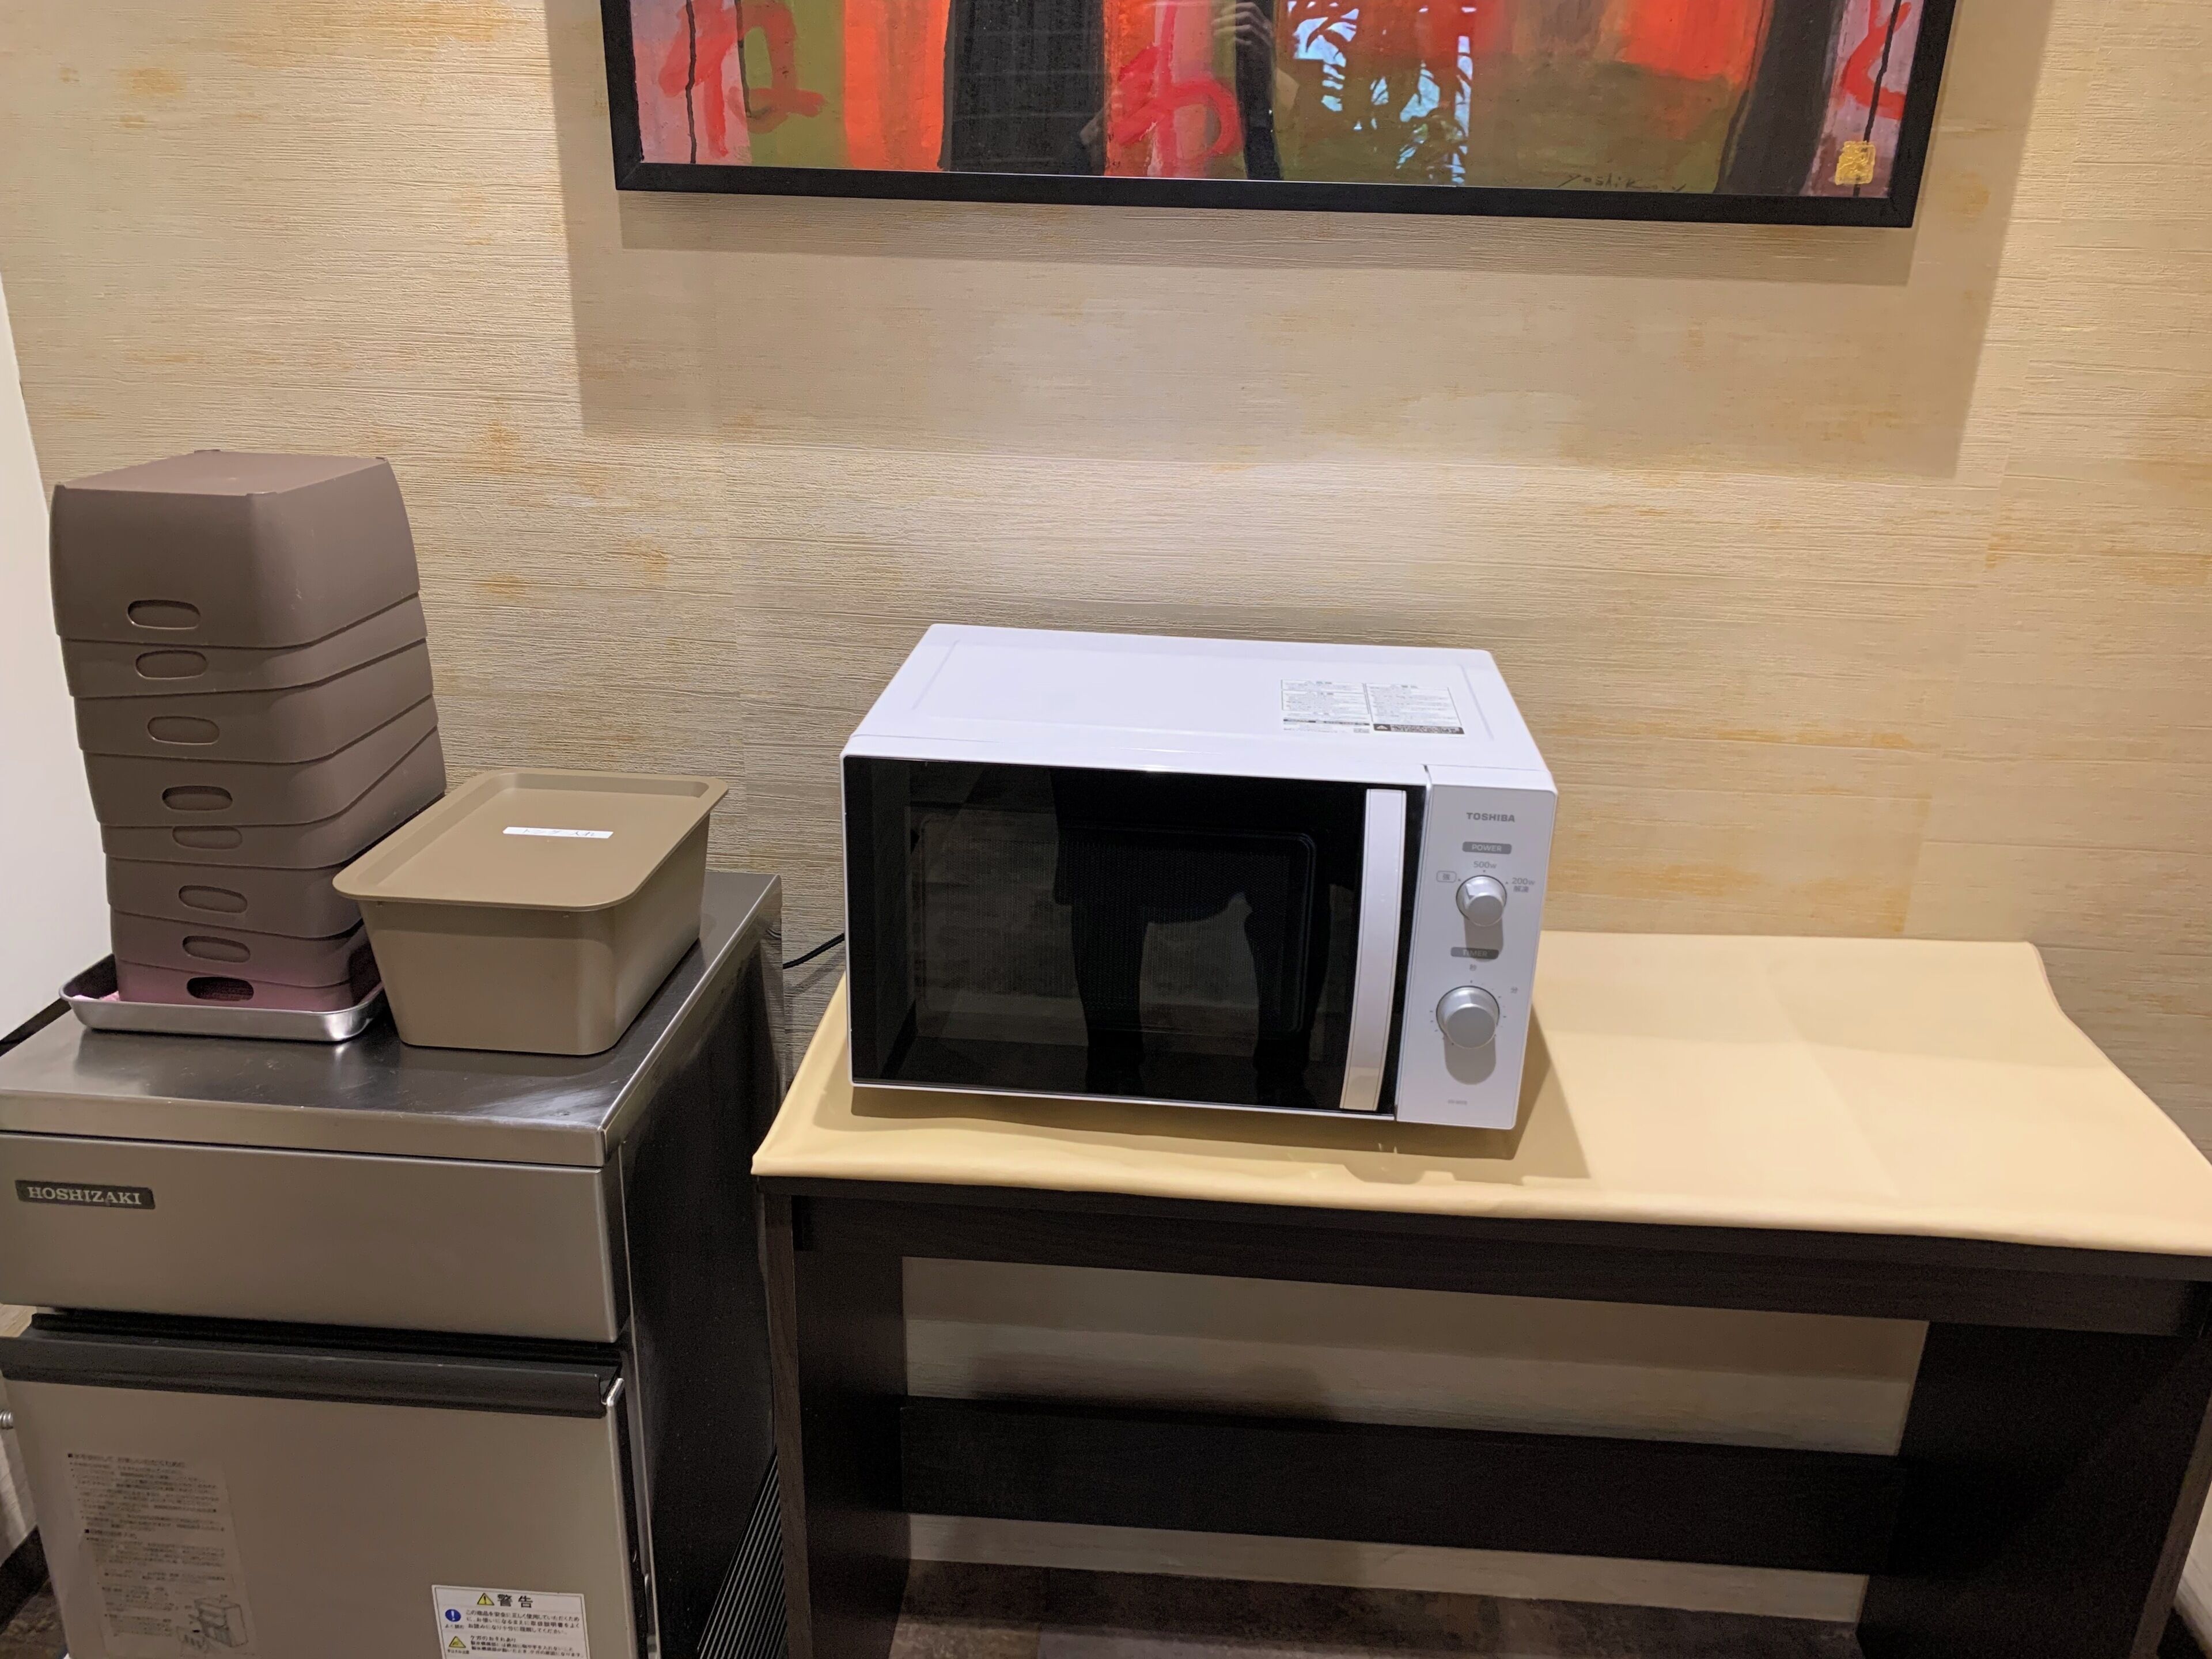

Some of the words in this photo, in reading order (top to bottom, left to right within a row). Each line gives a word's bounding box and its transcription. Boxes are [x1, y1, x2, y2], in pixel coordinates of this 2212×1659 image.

[1466, 812, 1516, 822] TOSHIBA
[1471, 844, 1502, 852] POWER
[1462, 949, 1488, 957] TIMER
[26, 1186, 142, 1205] HOSHIZAKI
[497, 1593, 533, 1608] 警告
